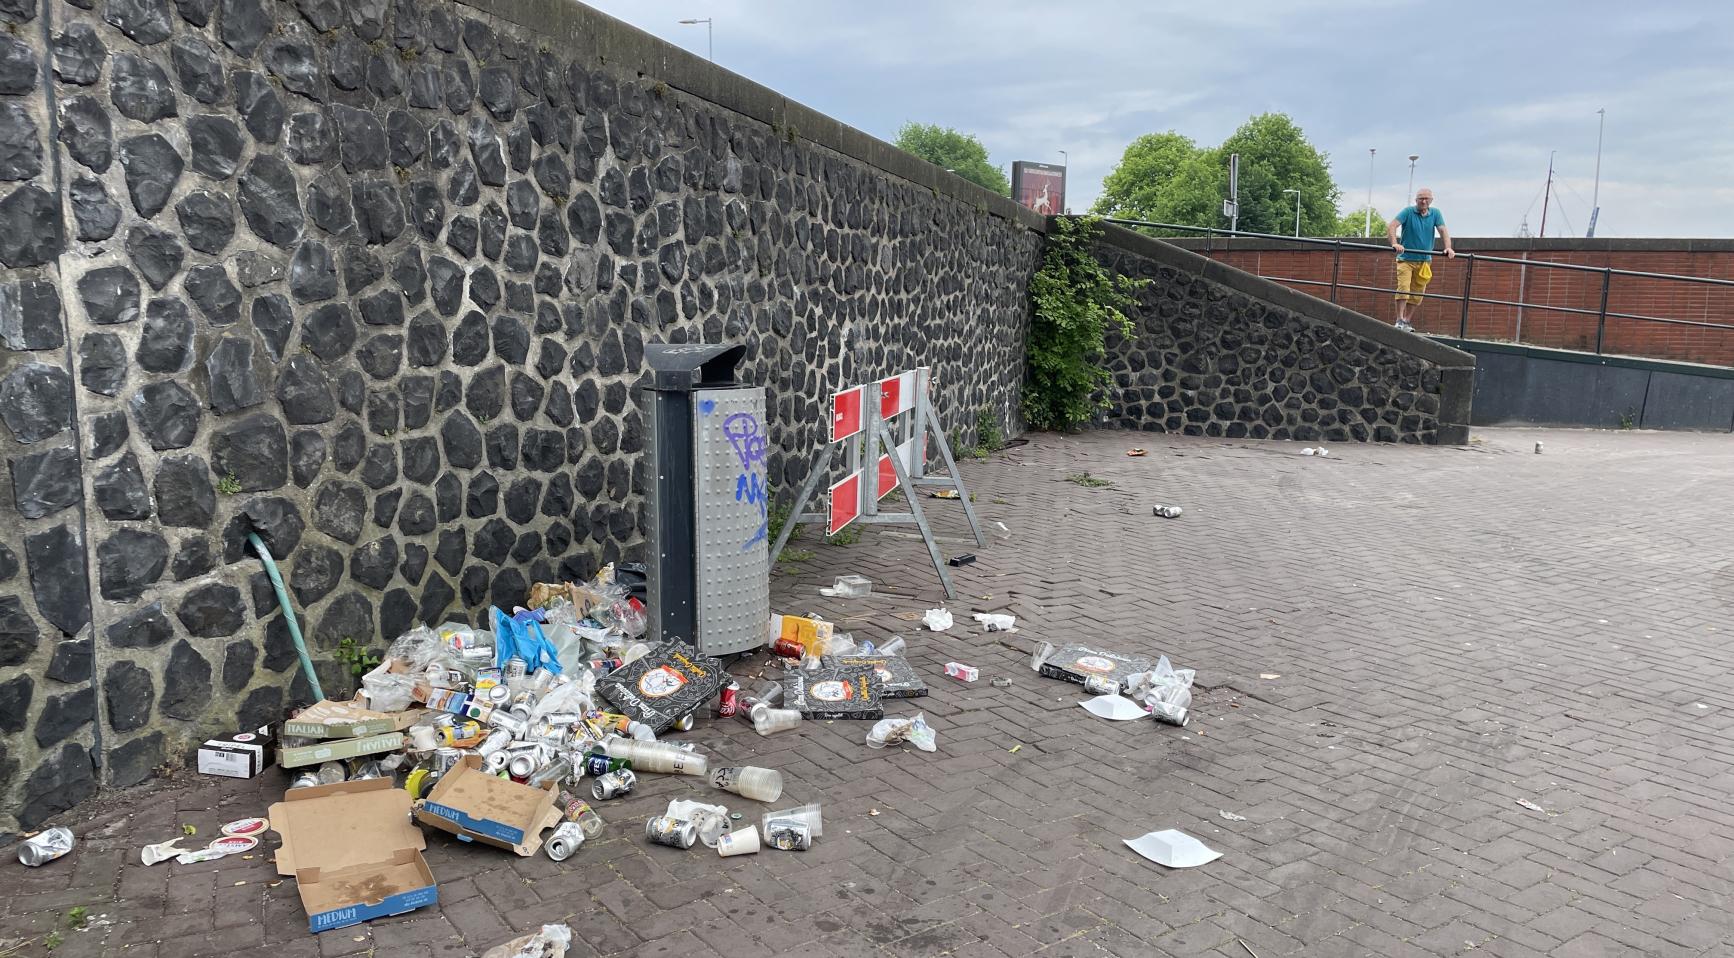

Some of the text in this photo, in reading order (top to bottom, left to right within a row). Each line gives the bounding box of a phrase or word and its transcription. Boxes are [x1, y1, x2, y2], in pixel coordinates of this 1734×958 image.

[287, 723, 325, 736] ITALIAN
[428, 803, 461, 821] MEDIUM
[317, 907, 357, 926] MEDIUM
